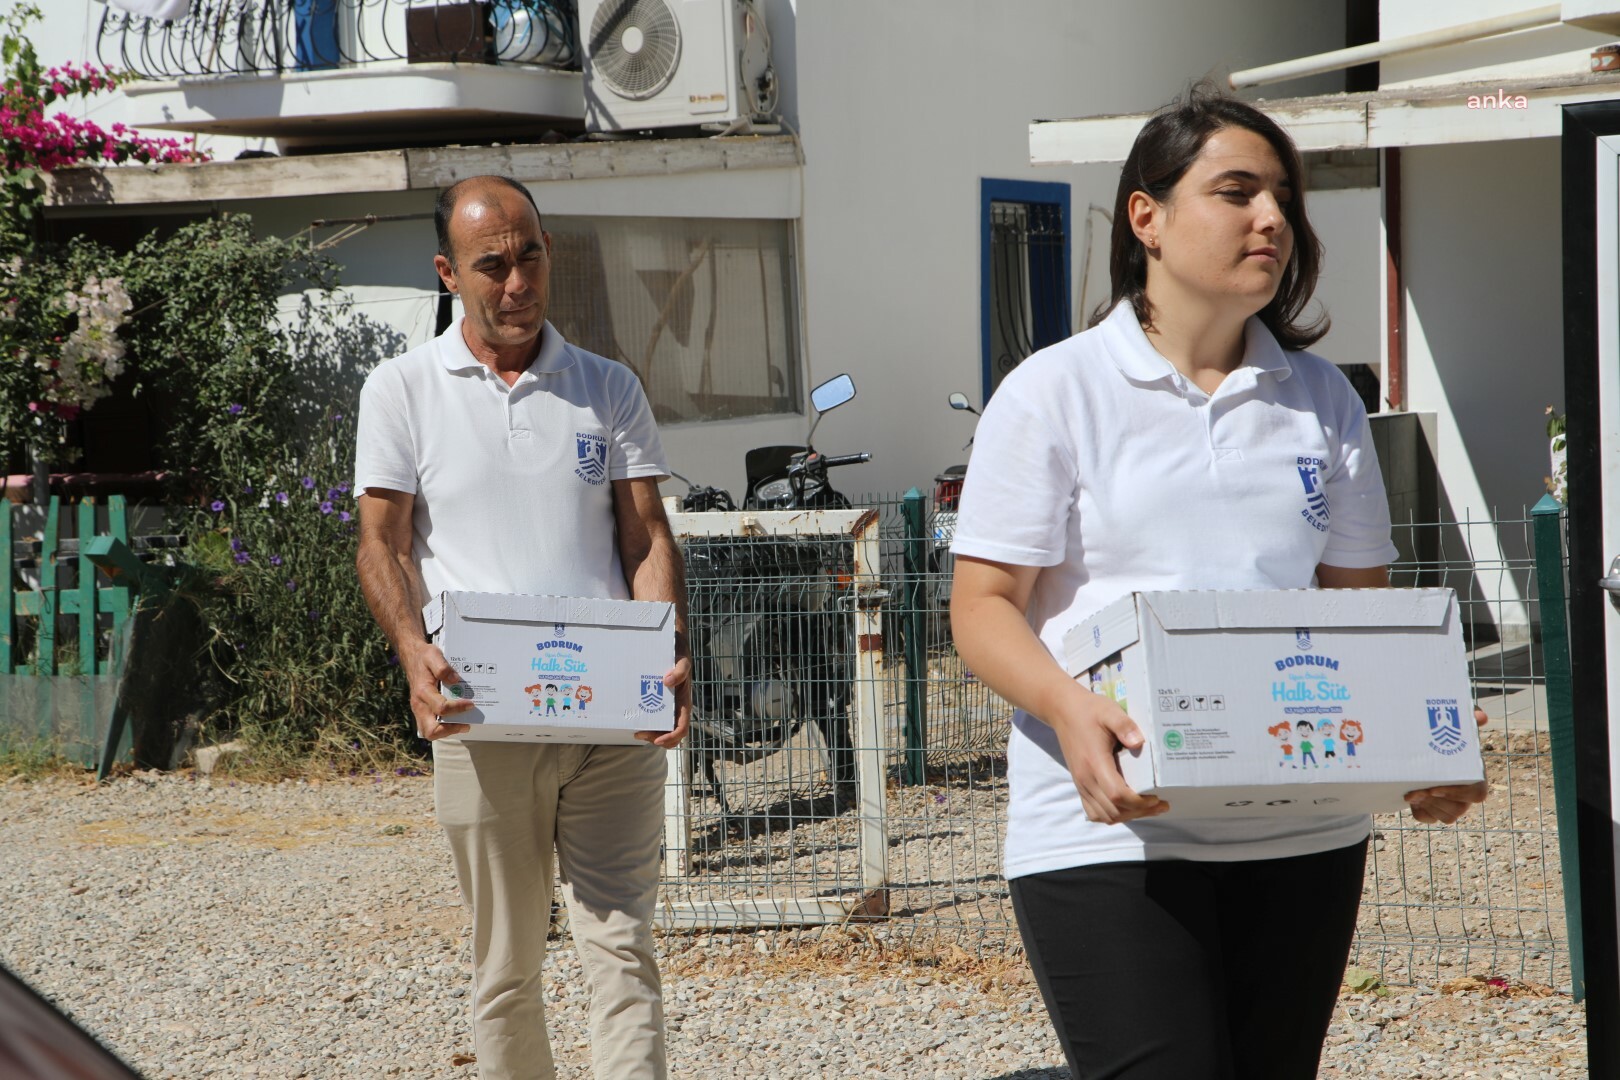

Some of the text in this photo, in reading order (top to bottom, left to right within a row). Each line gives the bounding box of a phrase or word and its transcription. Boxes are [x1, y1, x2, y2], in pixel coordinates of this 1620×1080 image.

[536, 640, 583, 653] BODRUM
[531, 657, 588, 673] Halk Süt
[1274, 655, 1339, 671] BODRUM
[1271, 681, 1351, 702] Halk Süt
[1428, 740, 1468, 756] BELEDİYESİ
